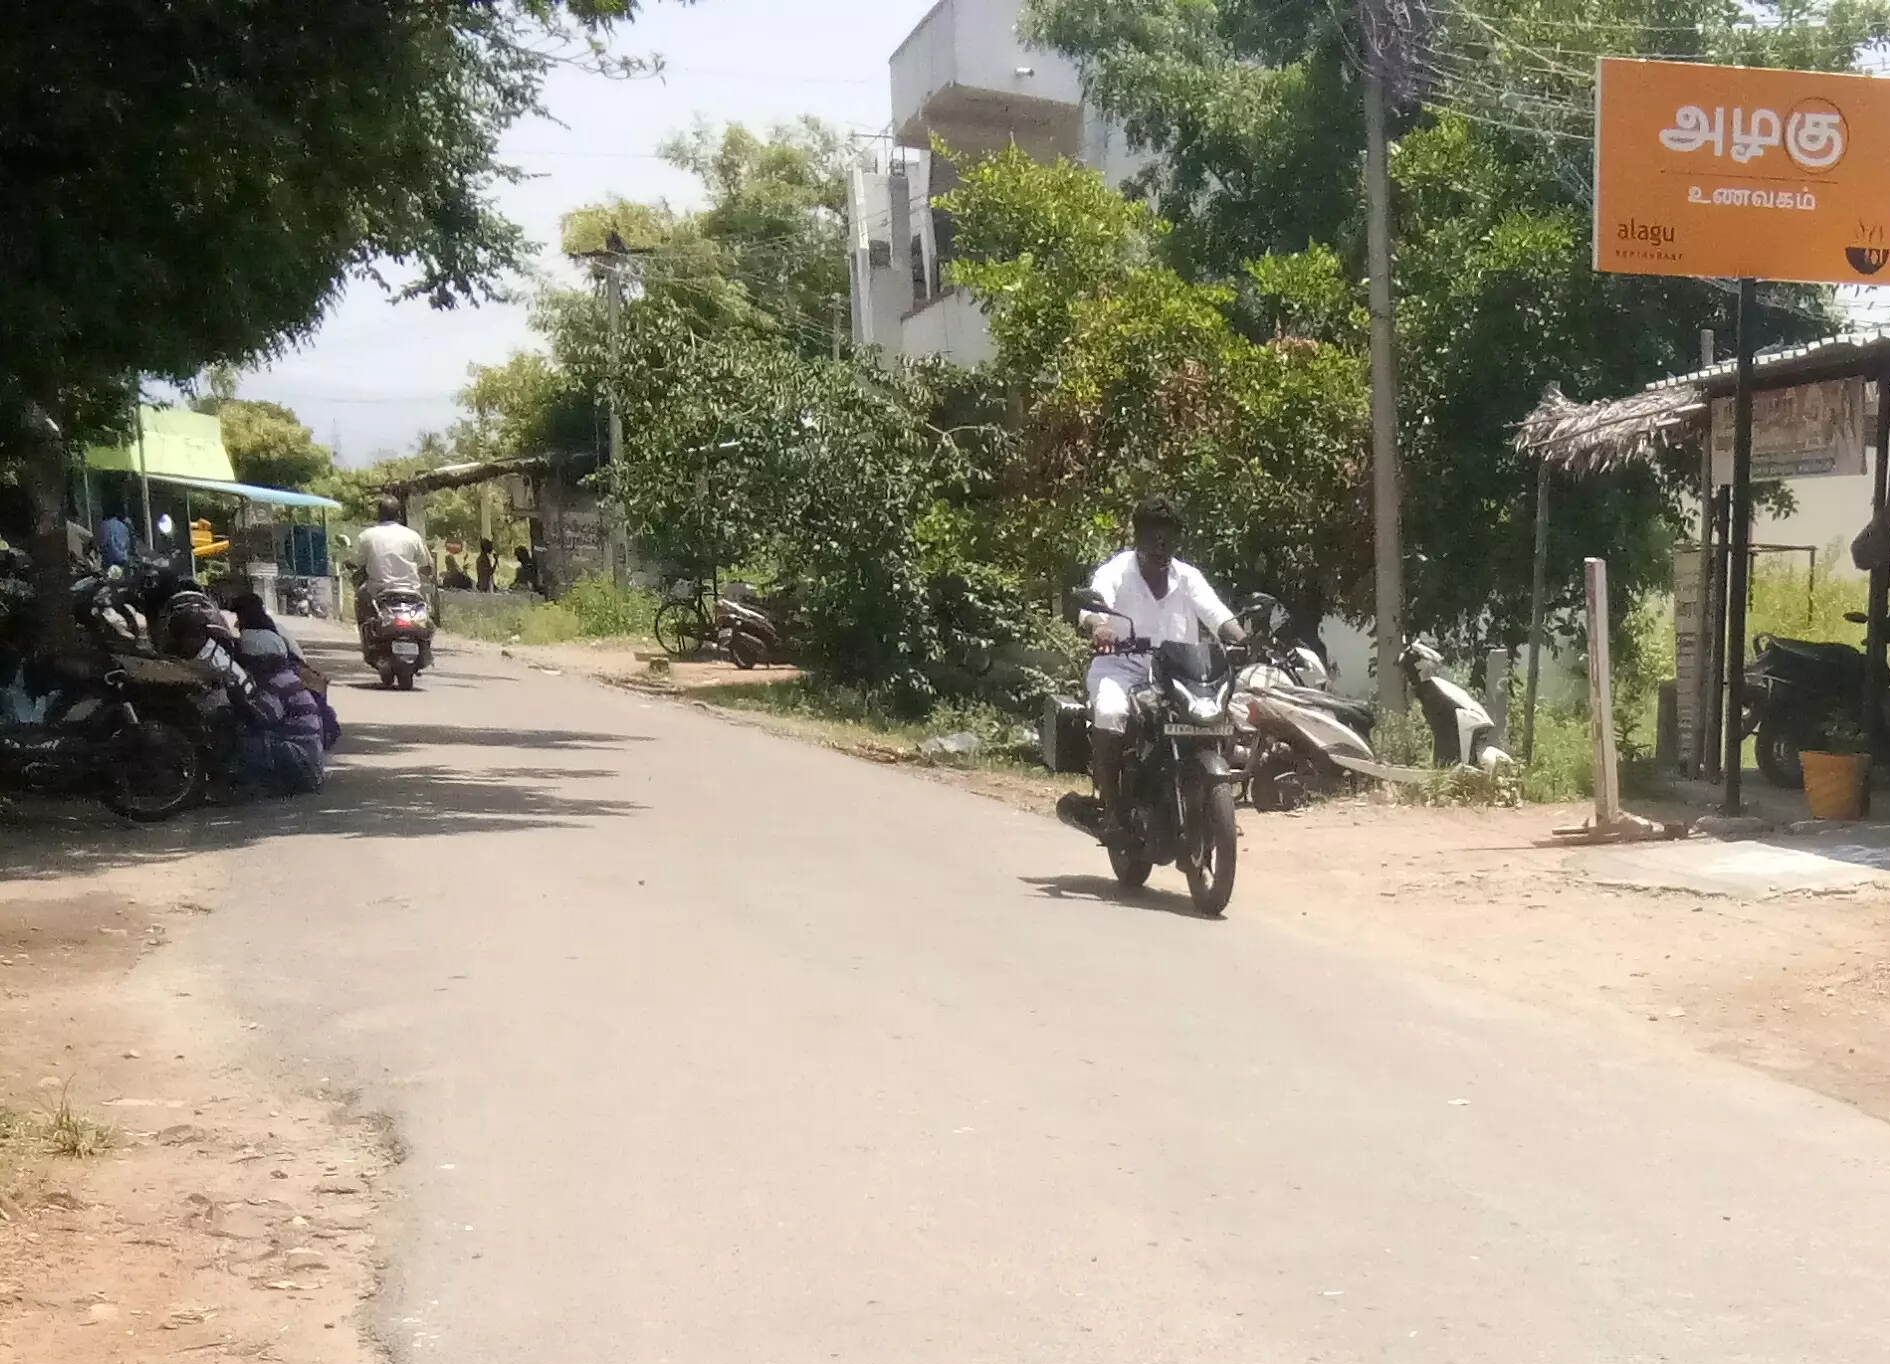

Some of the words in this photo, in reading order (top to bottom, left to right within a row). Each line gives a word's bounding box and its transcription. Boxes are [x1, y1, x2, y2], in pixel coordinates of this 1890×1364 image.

[1659, 104, 1844, 168] அழகு
[1687, 184, 1817, 212] உணவகம்
[1617, 217, 1675, 247] alagu
